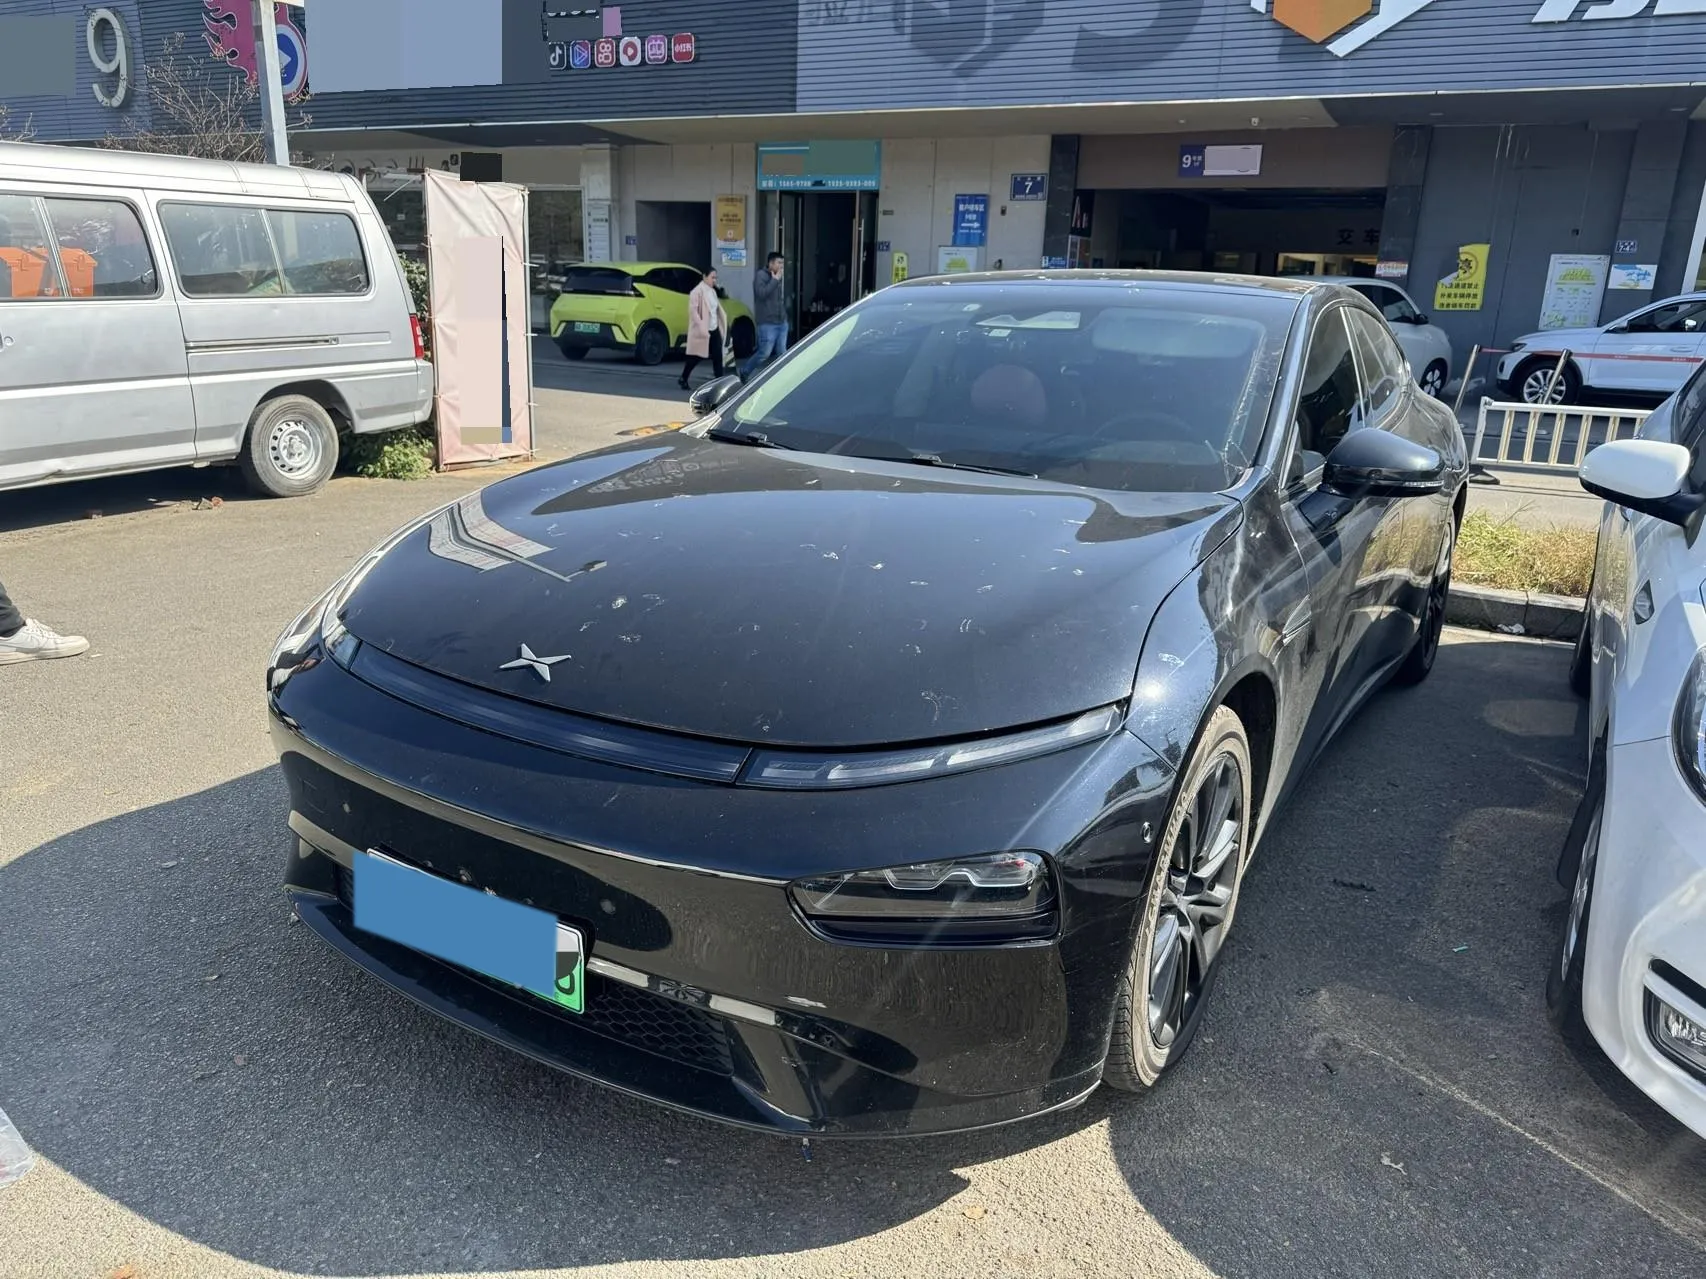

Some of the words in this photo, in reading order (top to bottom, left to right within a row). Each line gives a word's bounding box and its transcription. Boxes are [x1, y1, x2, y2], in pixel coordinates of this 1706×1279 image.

[86, 9, 130, 108] 9
[1182, 154, 1192, 168] 9
[1024, 181, 1033, 194] 7
